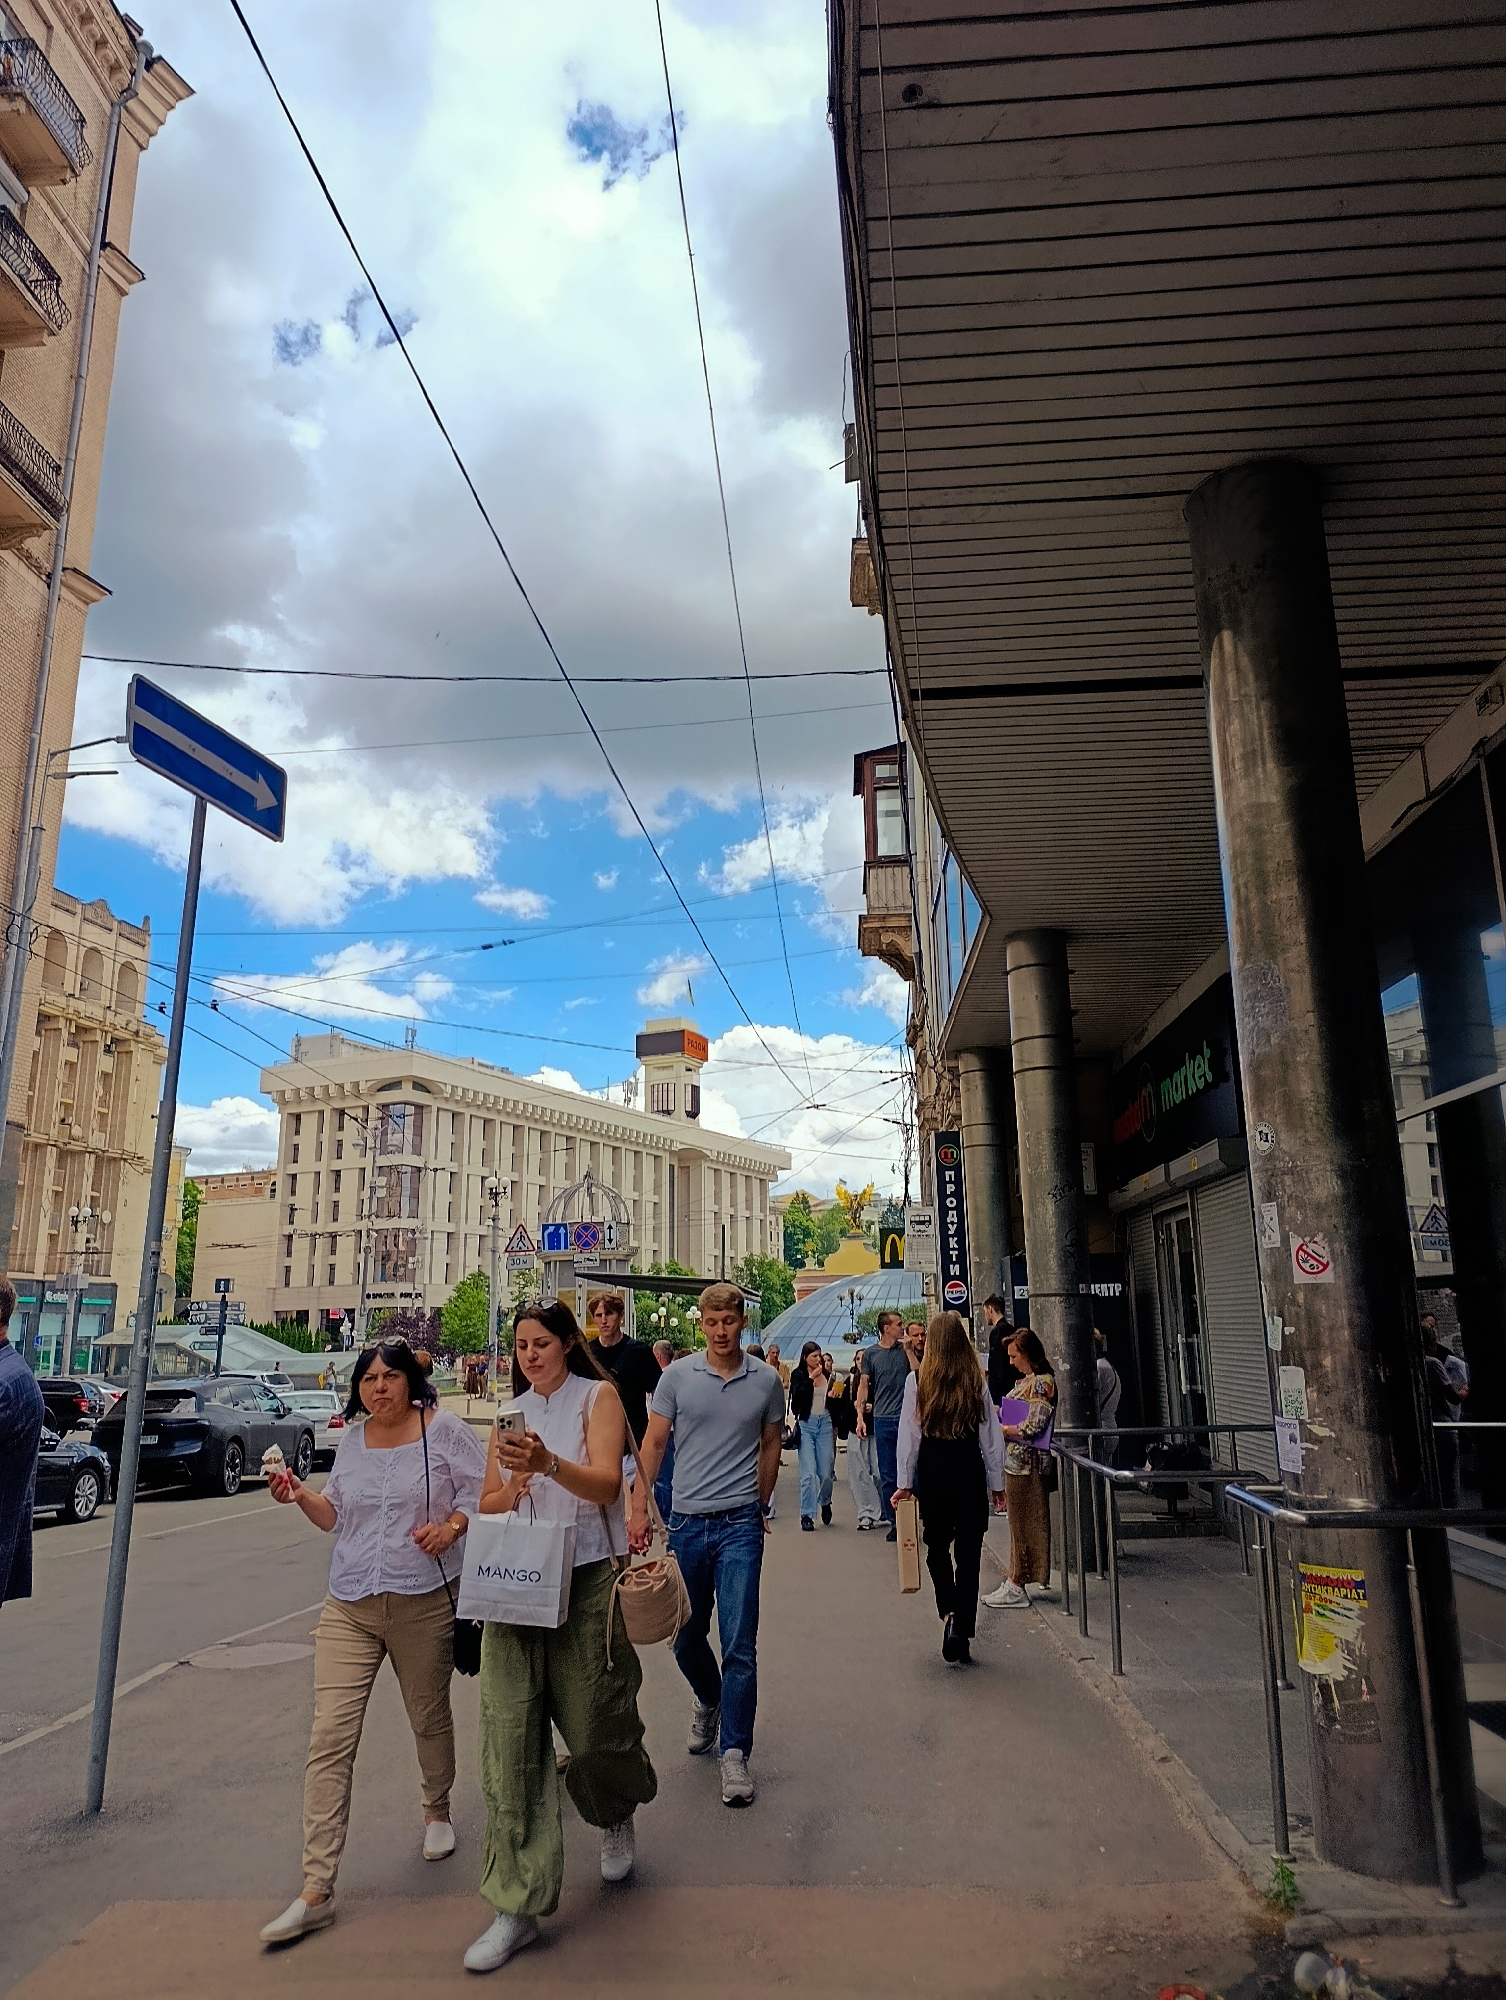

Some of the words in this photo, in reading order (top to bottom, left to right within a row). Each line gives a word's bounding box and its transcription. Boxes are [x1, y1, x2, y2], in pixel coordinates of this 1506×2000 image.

[1161, 1040, 1212, 1112] market
[945, 1171, 960, 1275] ПРОДУКТИ
[510, 1258, 521, 1266] 30
[477, 1565, 541, 1583] MANGO
